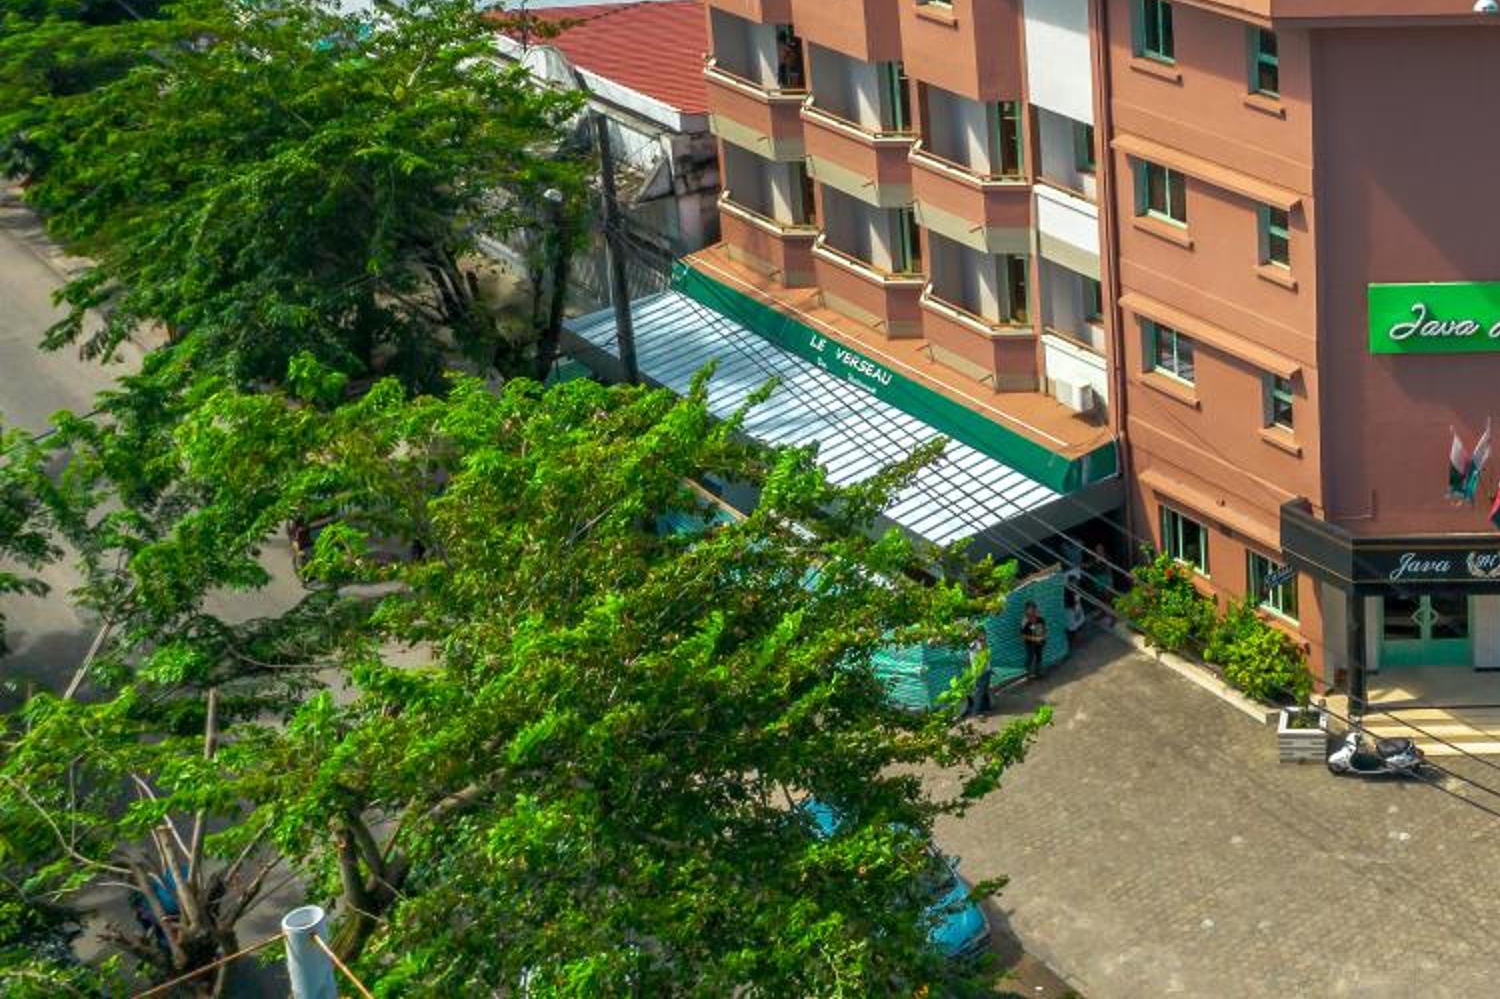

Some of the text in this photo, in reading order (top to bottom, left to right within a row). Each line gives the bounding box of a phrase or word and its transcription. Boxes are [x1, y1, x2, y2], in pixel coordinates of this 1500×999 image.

[1389, 303, 1480, 340] Java
[809, 334, 827, 352] LE
[836, 347, 893, 386] VERSEAU
[1389, 552, 1451, 582] Java
